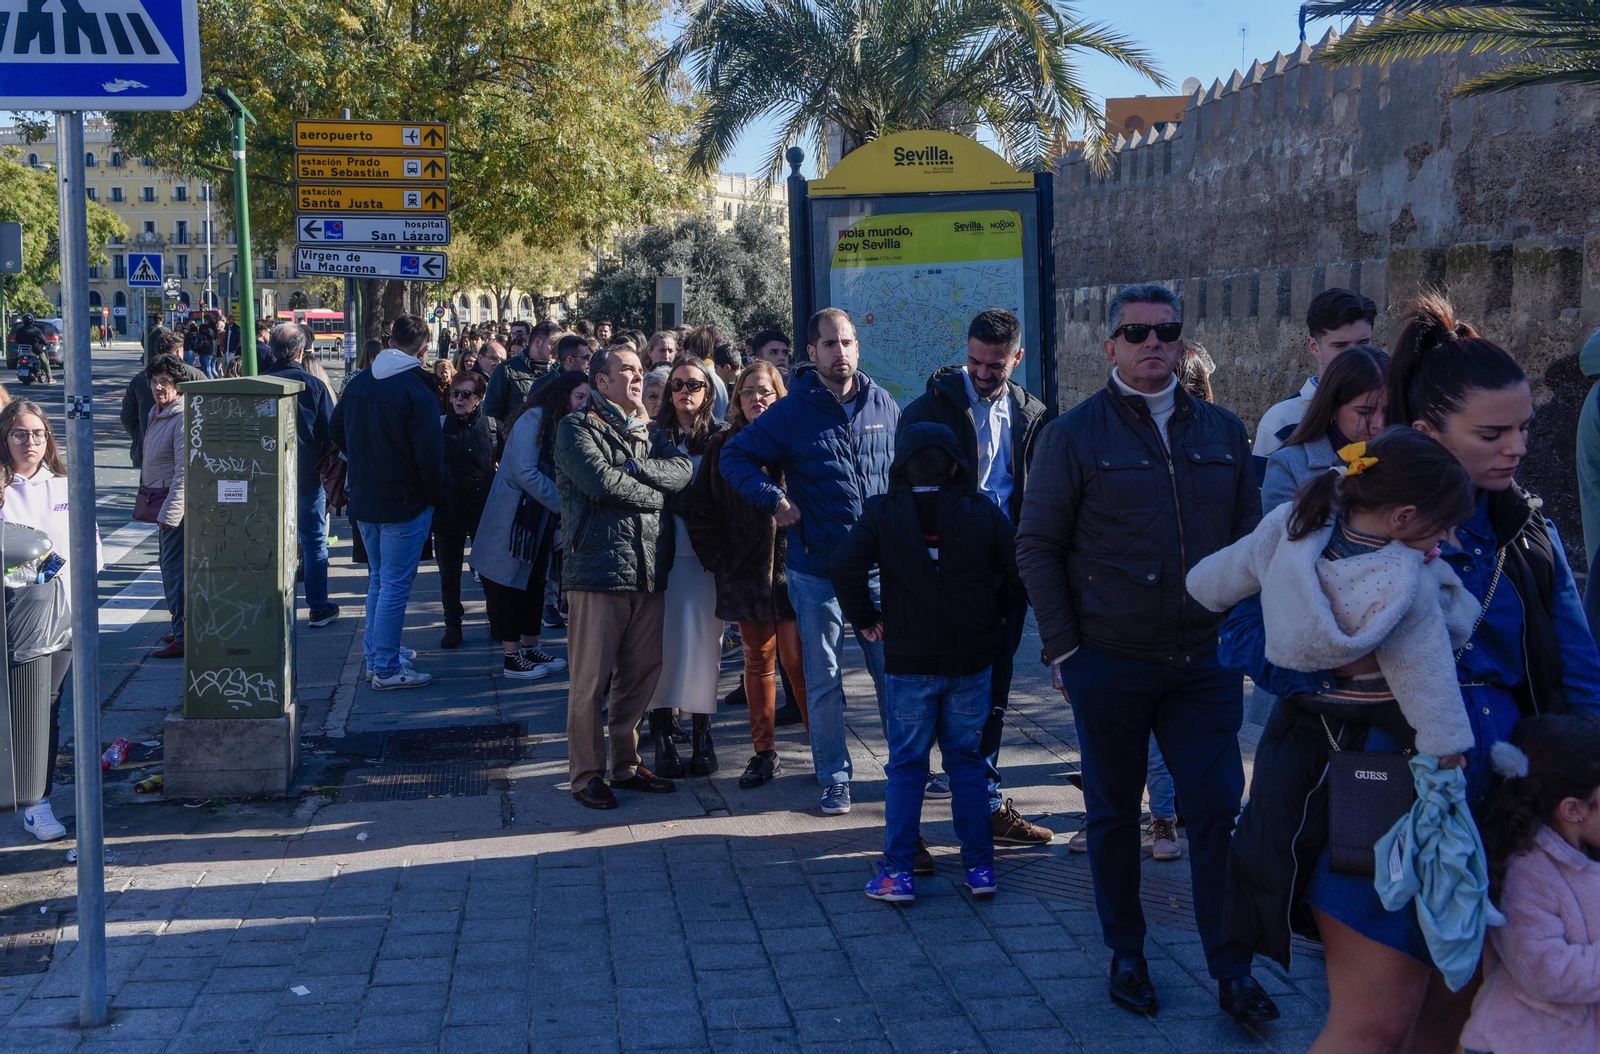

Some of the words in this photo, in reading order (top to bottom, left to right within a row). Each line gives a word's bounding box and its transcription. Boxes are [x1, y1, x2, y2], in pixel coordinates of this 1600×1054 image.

[300, 130, 372, 142] aeropuerto
[348, 158, 380, 166] Prado
[302, 168, 324, 176] San
[331, 168, 389, 177] Sebastián
[302, 198, 340, 208] Santa
[348, 199, 383, 209] Justa
[405, 221, 444, 229] hospital
[371, 231, 396, 240] San
[403, 231, 444, 241] Lázaro
[868, 225, 912, 237] mundo,
[838, 243, 859, 253] soy
[862, 239, 900, 250] Sevilla
[302, 250, 340, 261] Virgen
[346, 253, 360, 262] de
[300, 261, 311, 270] la
[318, 262, 376, 274] Macarena
[1355, 770, 1388, 781] GUESS
